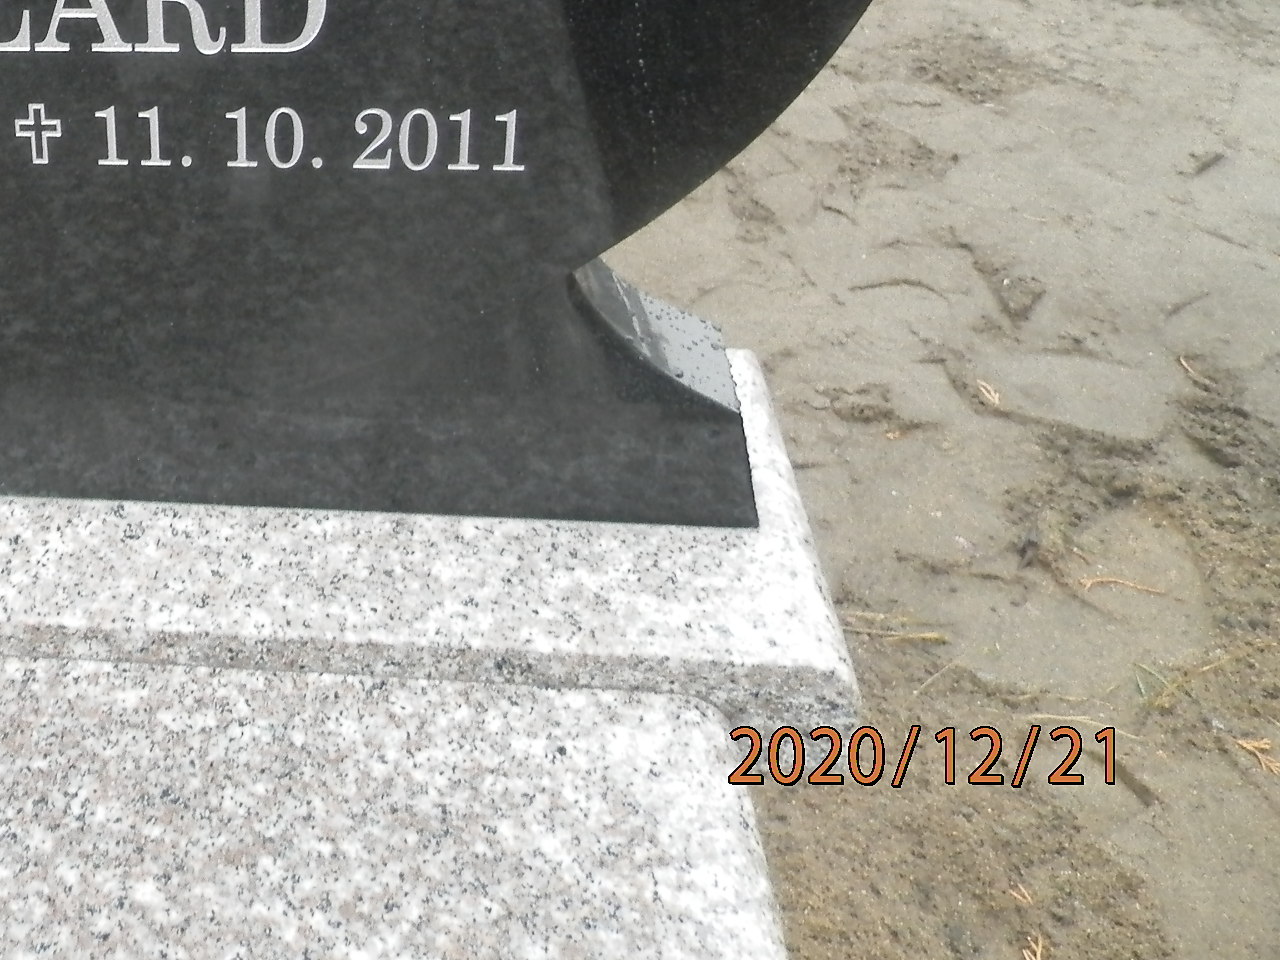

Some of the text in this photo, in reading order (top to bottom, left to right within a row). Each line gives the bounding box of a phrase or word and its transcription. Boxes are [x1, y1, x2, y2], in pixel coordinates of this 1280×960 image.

[94, 105, 193, 168] 11.
[225, 106, 324, 170] 10.
[352, 107, 526, 172] 2011
